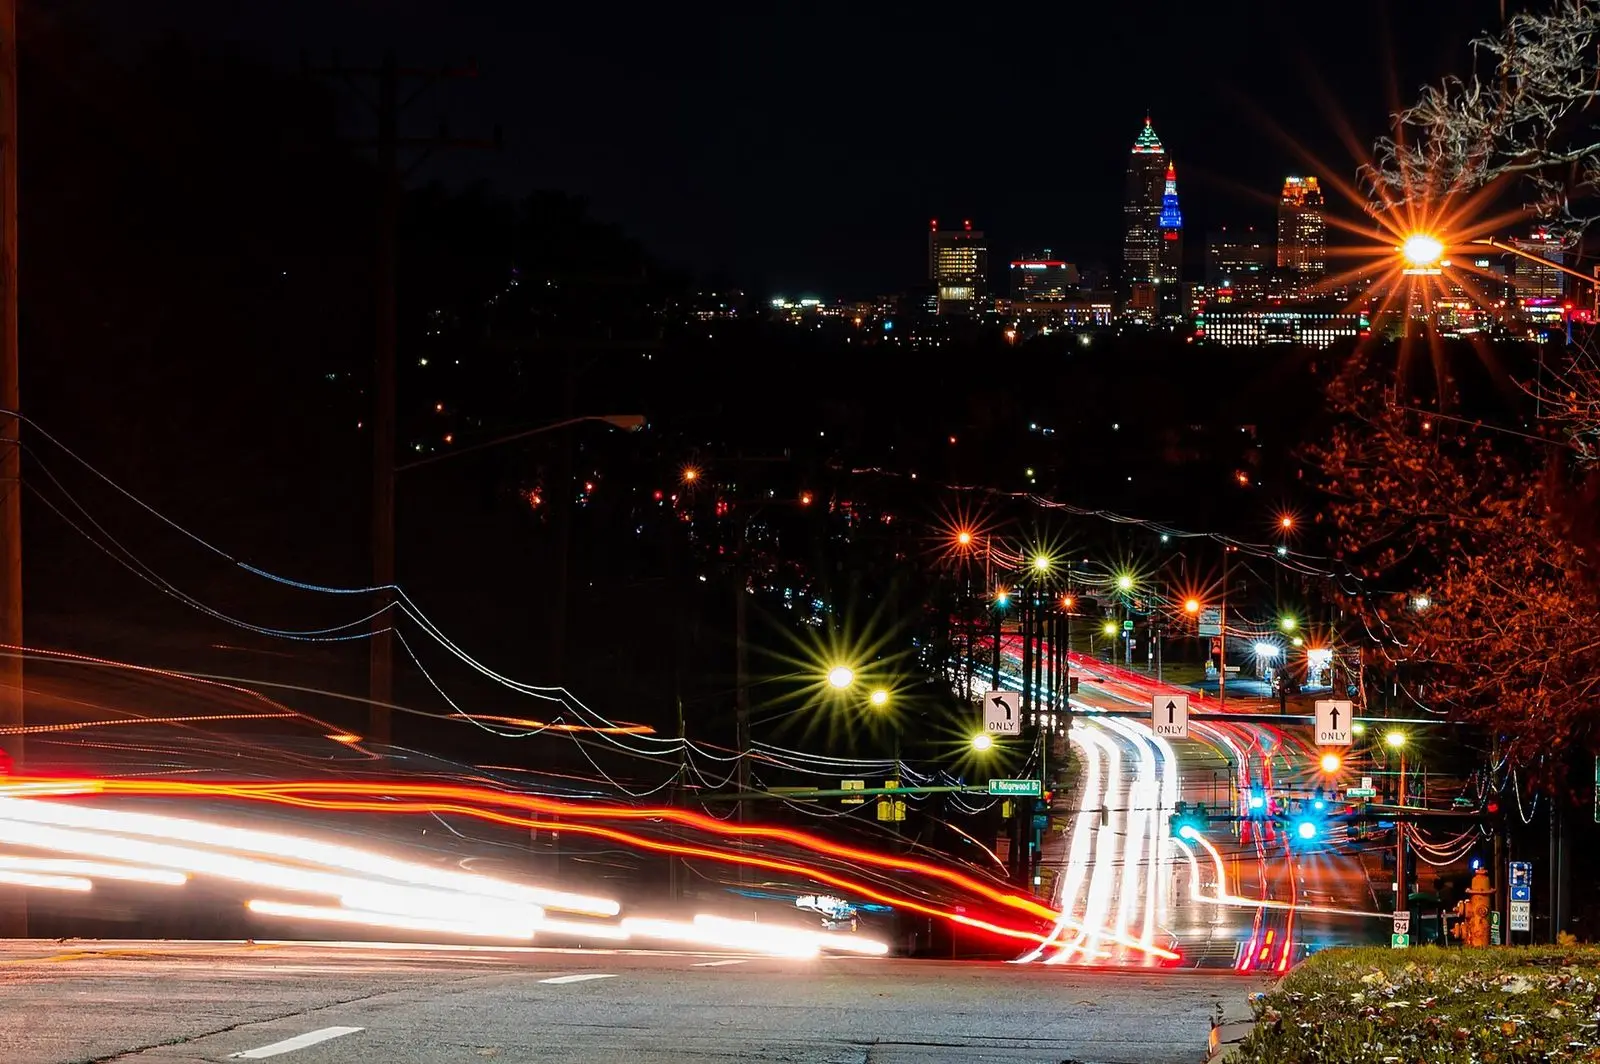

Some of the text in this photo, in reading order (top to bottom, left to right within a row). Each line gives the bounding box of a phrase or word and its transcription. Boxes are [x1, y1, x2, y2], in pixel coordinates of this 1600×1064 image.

[989, 721, 1015, 731] ONLY
[1157, 725, 1183, 734] ONLY
[1321, 732, 1346, 741] ONLY
[1511, 914, 1528, 922] BLOCK
[1394, 922, 1407, 931] 94
